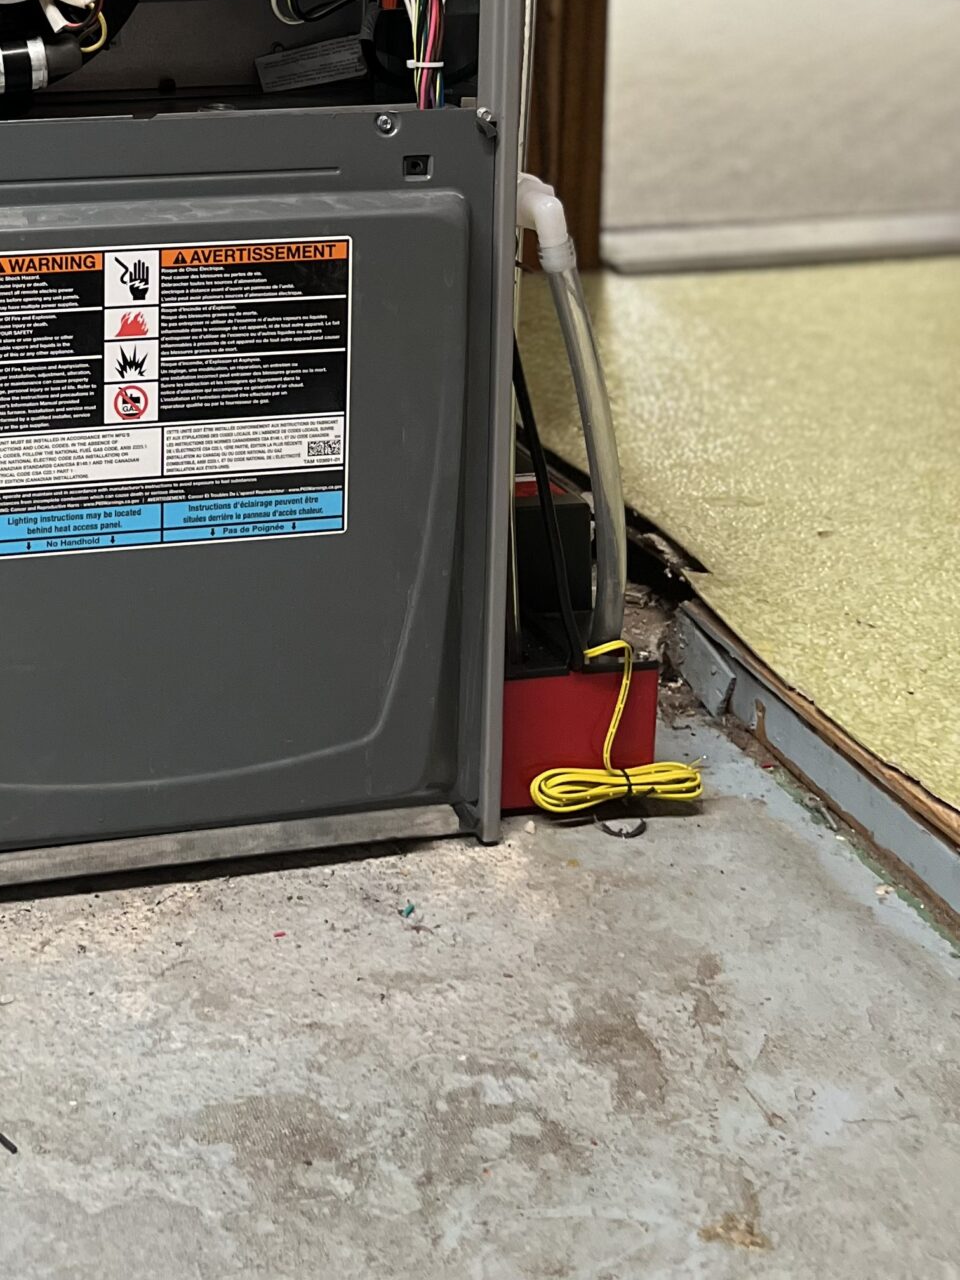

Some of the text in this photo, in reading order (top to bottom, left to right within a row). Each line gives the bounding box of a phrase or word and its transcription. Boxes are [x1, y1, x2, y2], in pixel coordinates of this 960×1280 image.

[189, 244, 336, 264] AVERTISSEMENT
[7, 255, 95, 272] WARNING
[122, 405, 139, 413] GA
[188, 502, 231, 512] Instructions
[233, 498, 272, 510] d'éclairage
[274, 497, 302, 506] peuvent
[304, 495, 318, 503] être
[7, 508, 141, 526] Lighting instructions may be located
[182, 514, 206, 523] situées
[242, 511, 270, 519] panneau
[26, 520, 122, 534] behind heat access panel.
[222, 526, 237, 534] Pas
[252, 523, 284, 533] Poignée
[60, 536, 99, 546] Handhold
